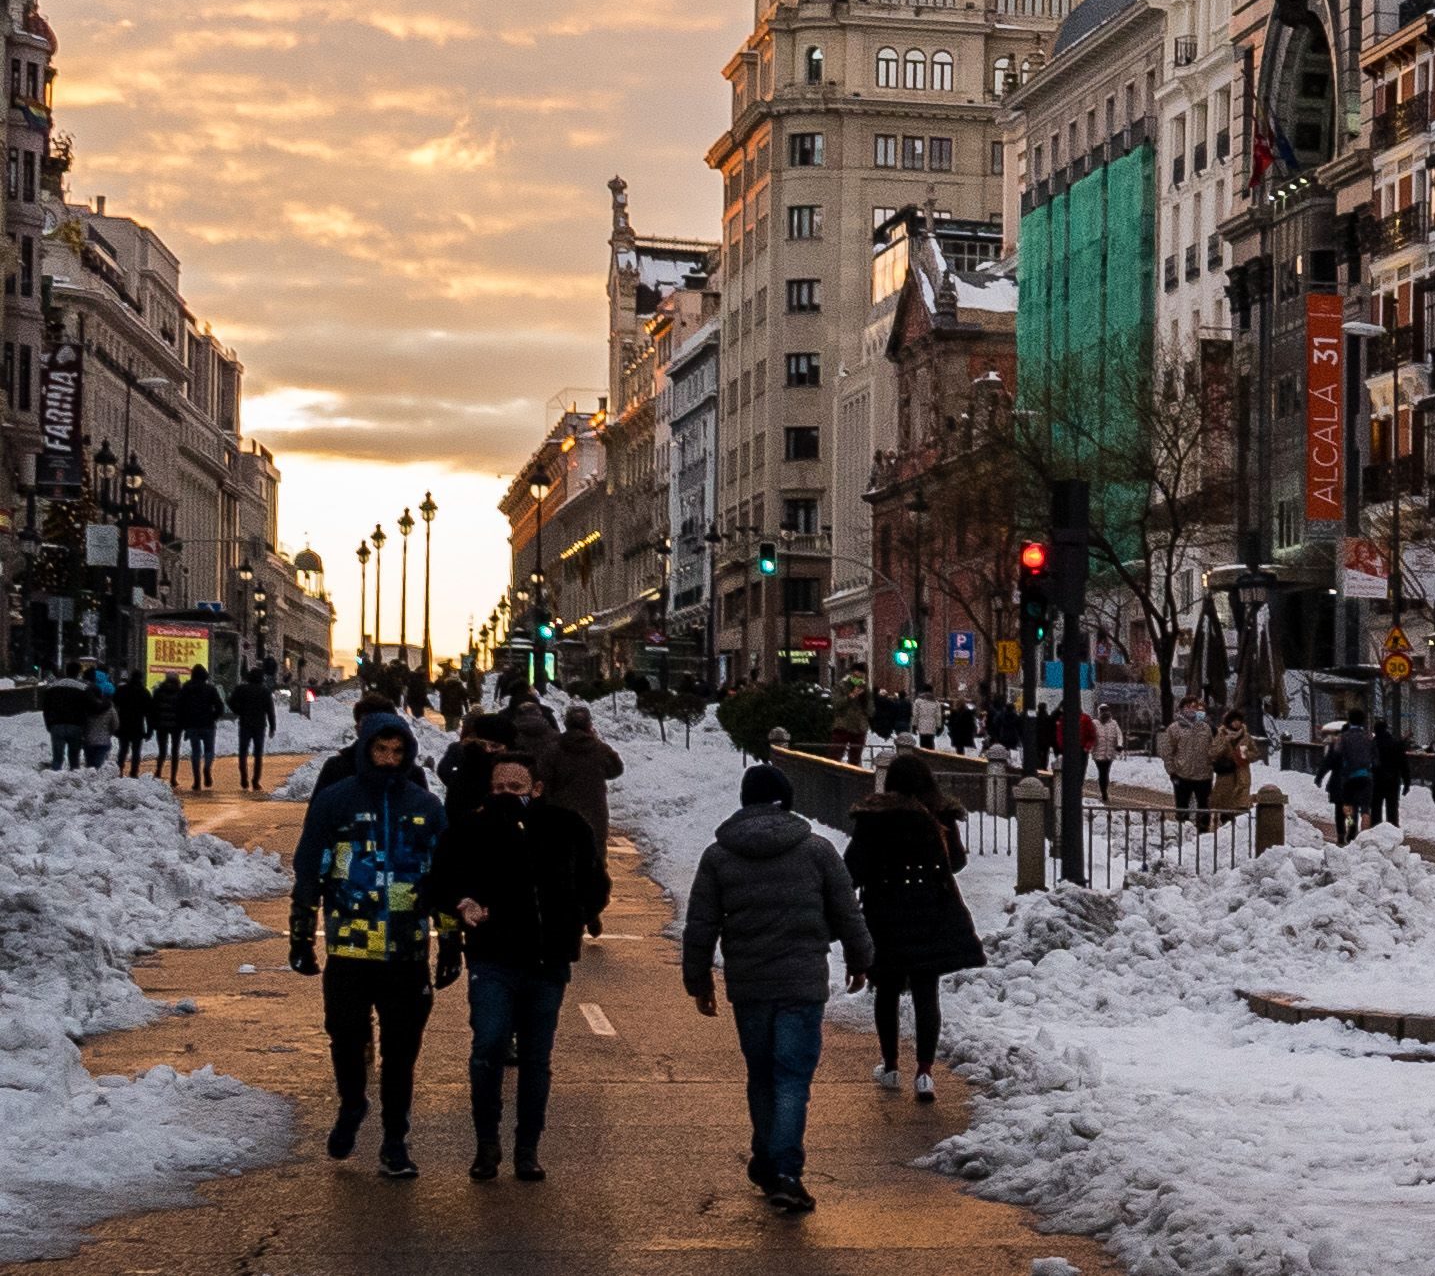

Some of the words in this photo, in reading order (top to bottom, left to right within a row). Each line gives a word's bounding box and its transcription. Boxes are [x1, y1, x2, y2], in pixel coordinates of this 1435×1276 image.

[1313, 337, 1339, 366] 31
[1309, 383, 1338, 506] ALCALÁ
[1389, 661, 1406, 674] 30
